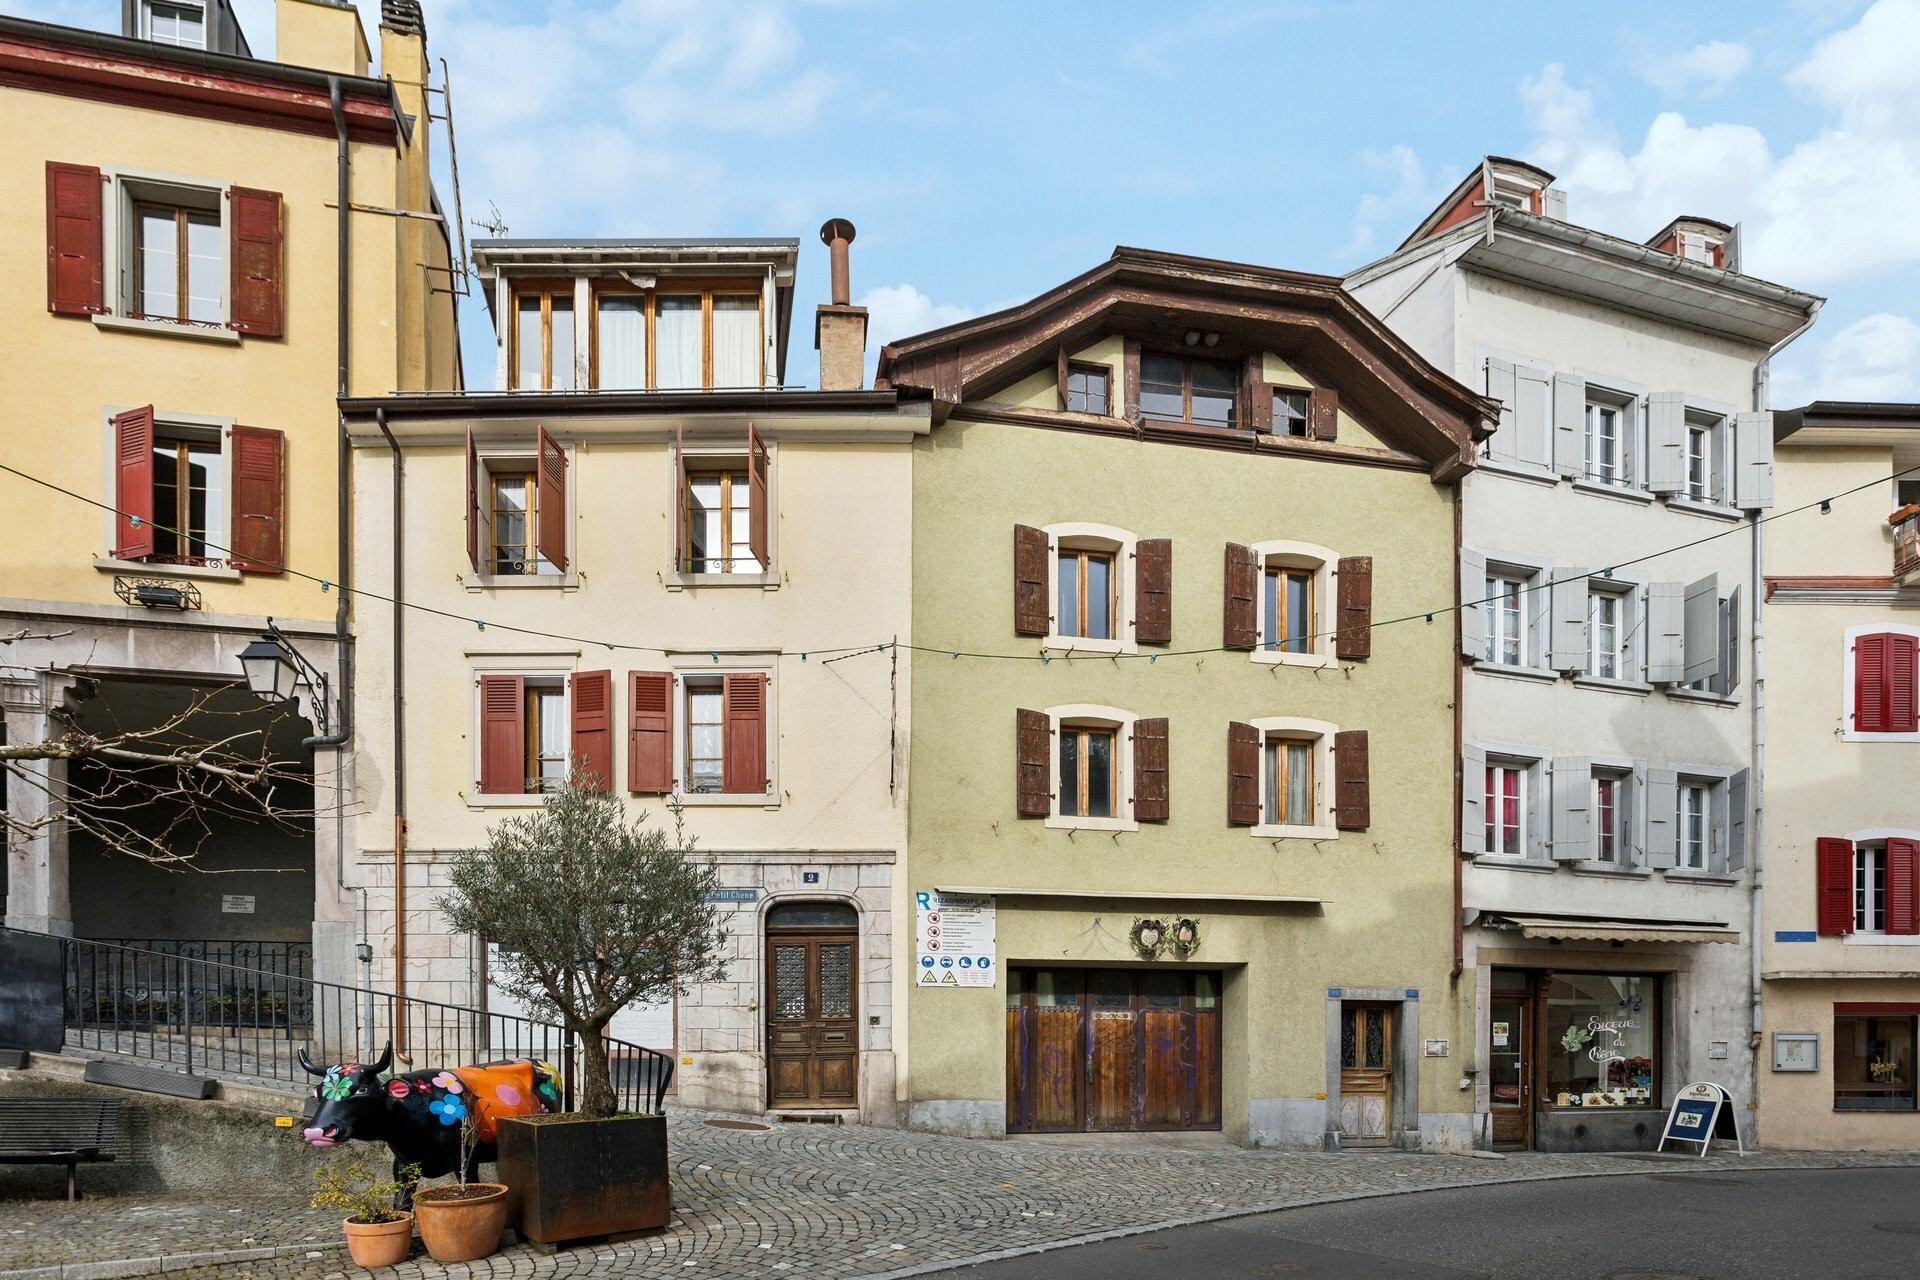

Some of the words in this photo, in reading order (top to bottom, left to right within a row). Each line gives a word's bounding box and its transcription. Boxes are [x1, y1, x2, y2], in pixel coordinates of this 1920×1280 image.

[807, 873, 814, 882] 2
[916, 892, 931, 910] R
[1613, 1031, 1627, 1047] du
